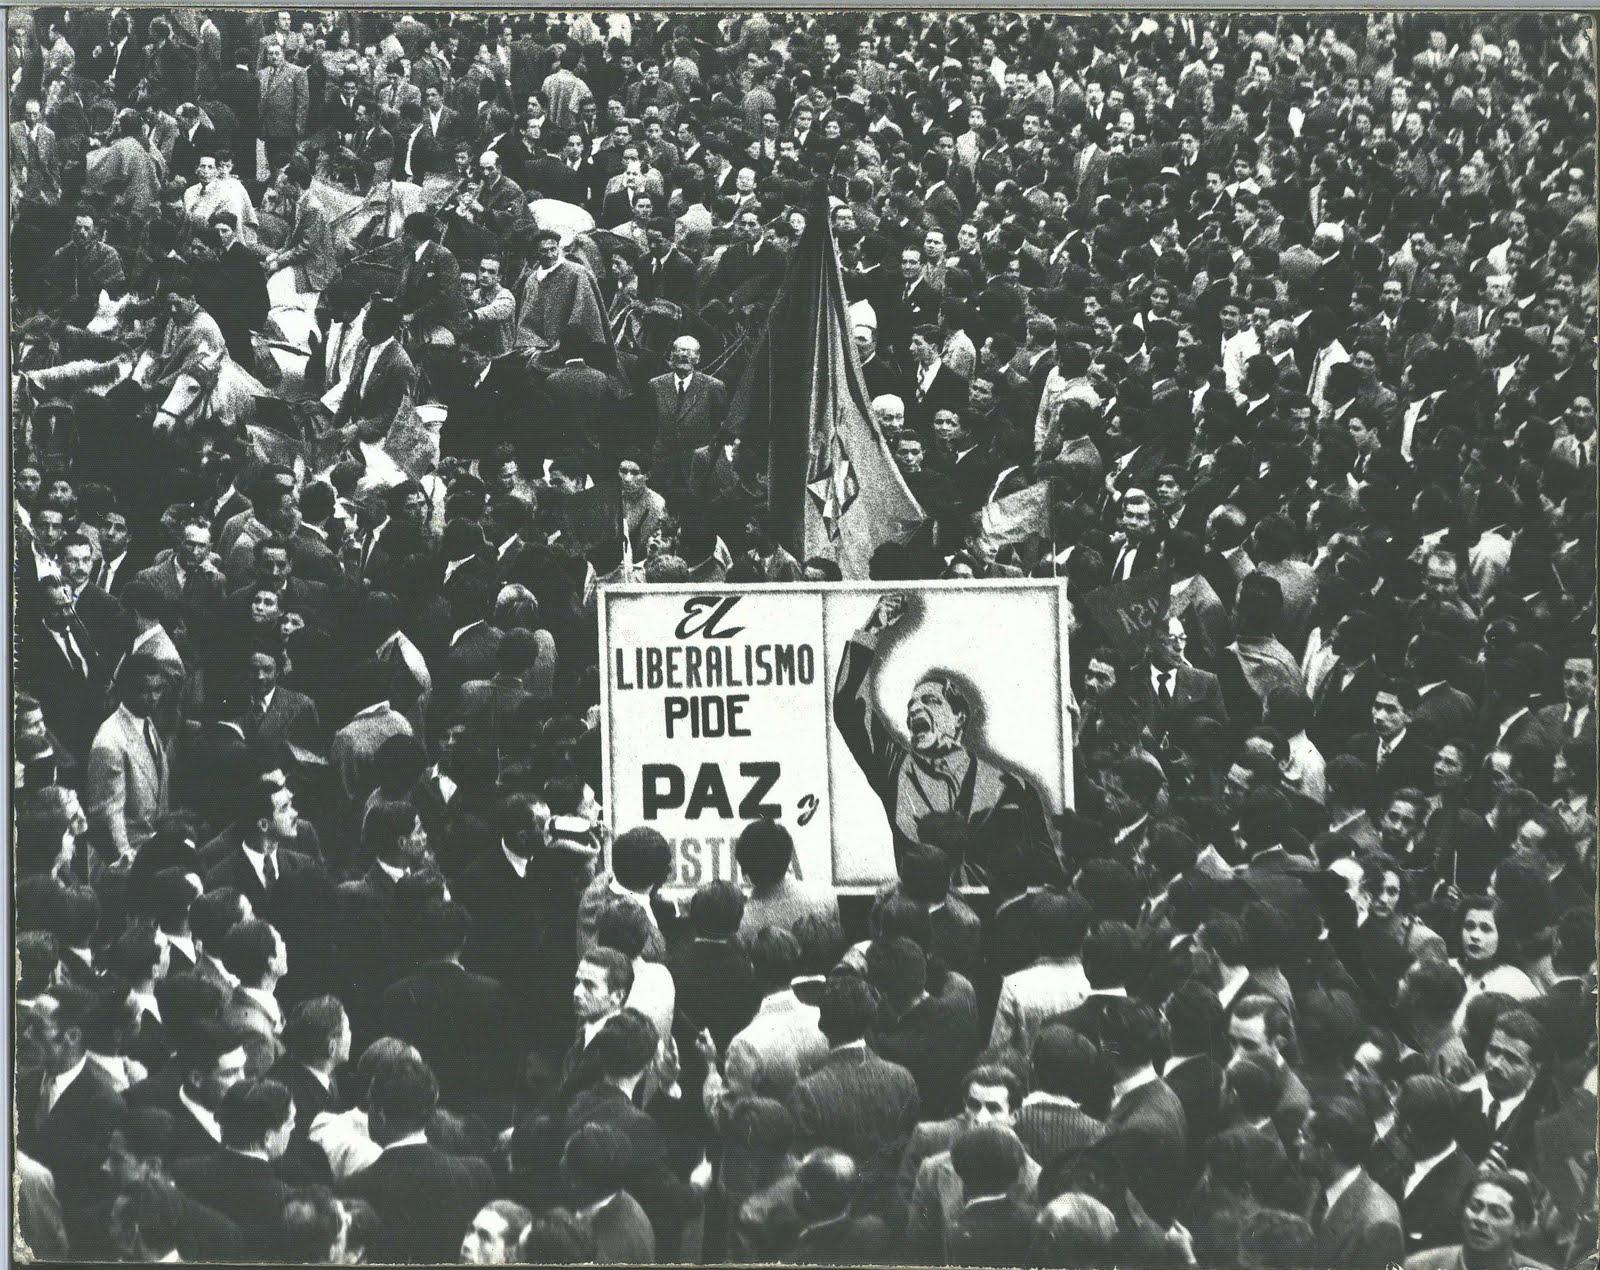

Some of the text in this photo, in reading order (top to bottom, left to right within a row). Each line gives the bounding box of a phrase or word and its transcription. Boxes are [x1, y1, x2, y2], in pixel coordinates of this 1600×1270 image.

[615, 643, 815, 690] LIBERALISMO
[664, 694, 752, 739] PIDE
[641, 761, 783, 821] PAZ
